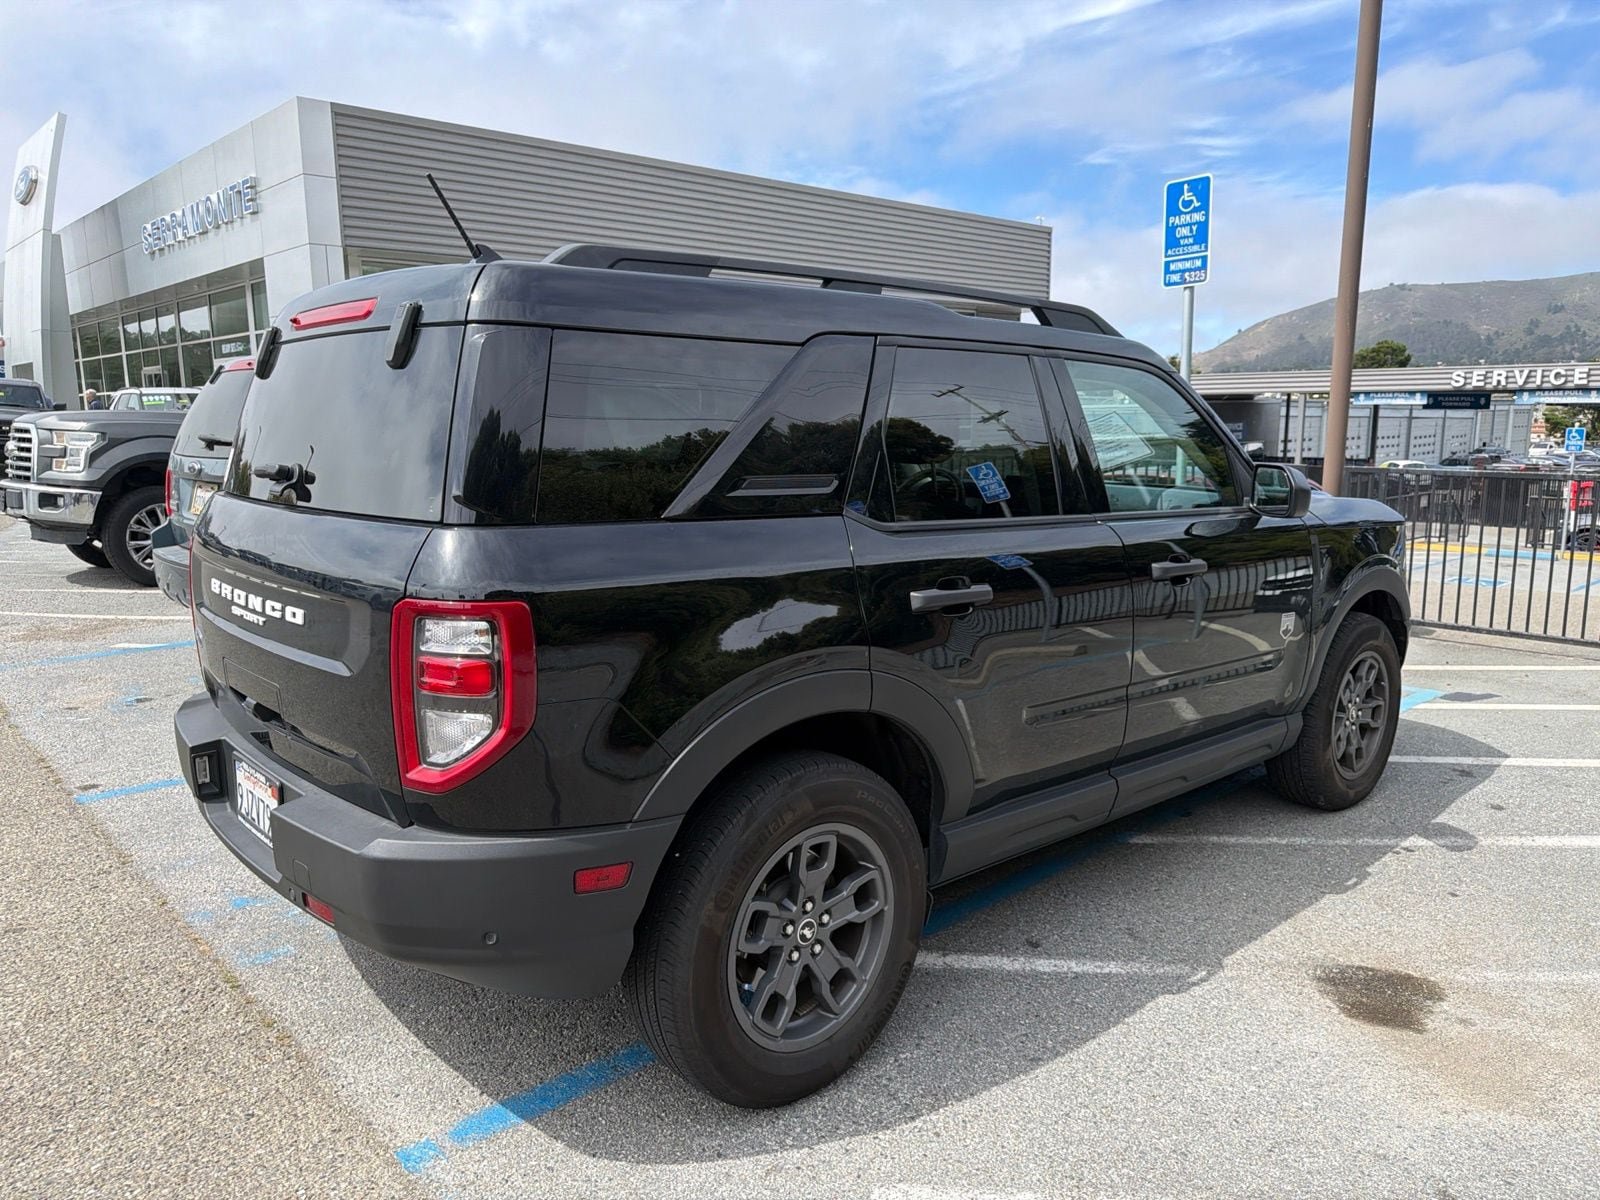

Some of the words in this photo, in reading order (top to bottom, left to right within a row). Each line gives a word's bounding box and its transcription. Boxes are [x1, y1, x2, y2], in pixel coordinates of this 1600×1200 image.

[141, 175, 258, 254] SERRAMONTE
[1168, 211, 1206, 227] PARKING
[1175, 225, 1198, 238] ONLY
[1180, 237, 1194, 246] VAN
[1166, 243, 1206, 256] ACCESSIBLE
[1169, 258, 1202, 271] MINIMUM
[1165, 272, 1182, 284] FINE
[1184, 270, 1206, 283] $325
[1450, 367, 1591, 388] SERVICE
[210, 577, 305, 626] BRONCO
[231, 605, 267, 626] SPORT
